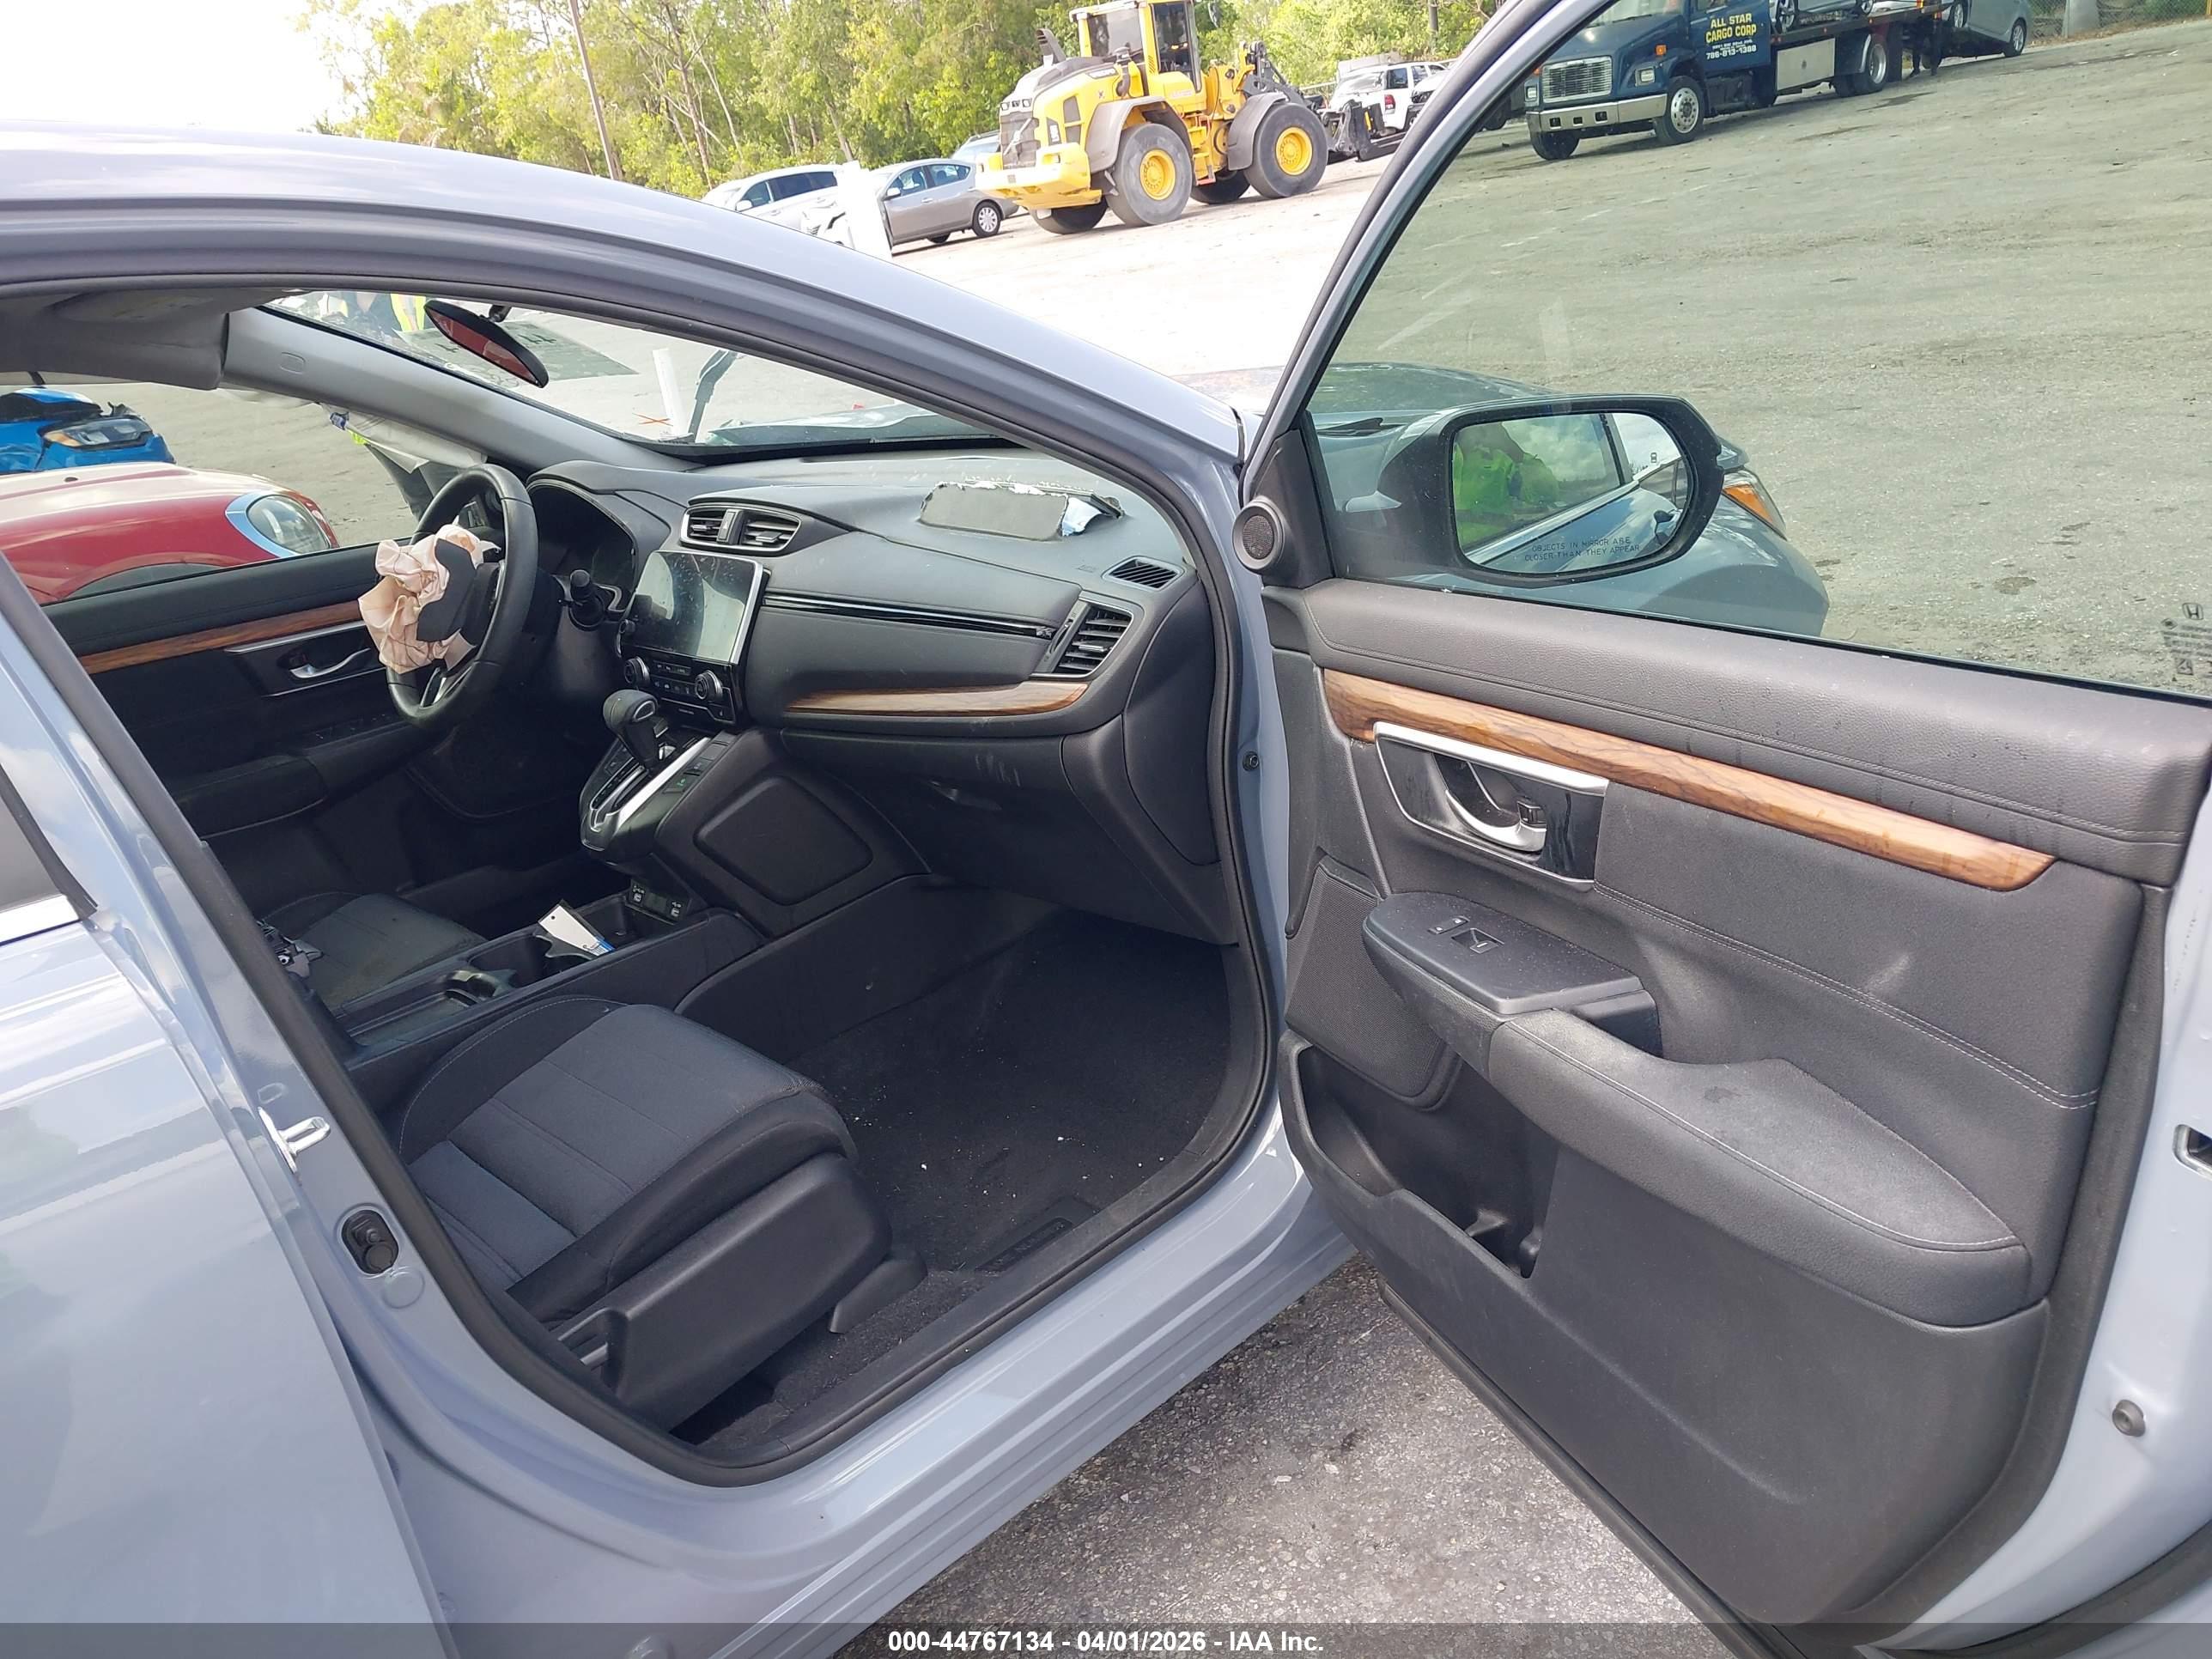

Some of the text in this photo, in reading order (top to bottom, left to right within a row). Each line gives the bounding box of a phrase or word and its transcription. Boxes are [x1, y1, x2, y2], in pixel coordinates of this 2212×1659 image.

[1711, 13, 1753, 29] ALL STAR
[1705, 24, 1757, 44] CARGO CORP
[1524, 544, 1640, 562] CLOSER THAN THEY APPEAR
[1532, 542, 1565, 553] OBJECTS
[1582, 538, 1609, 547] MIRROR
[1613, 536, 1632, 544] ARE
